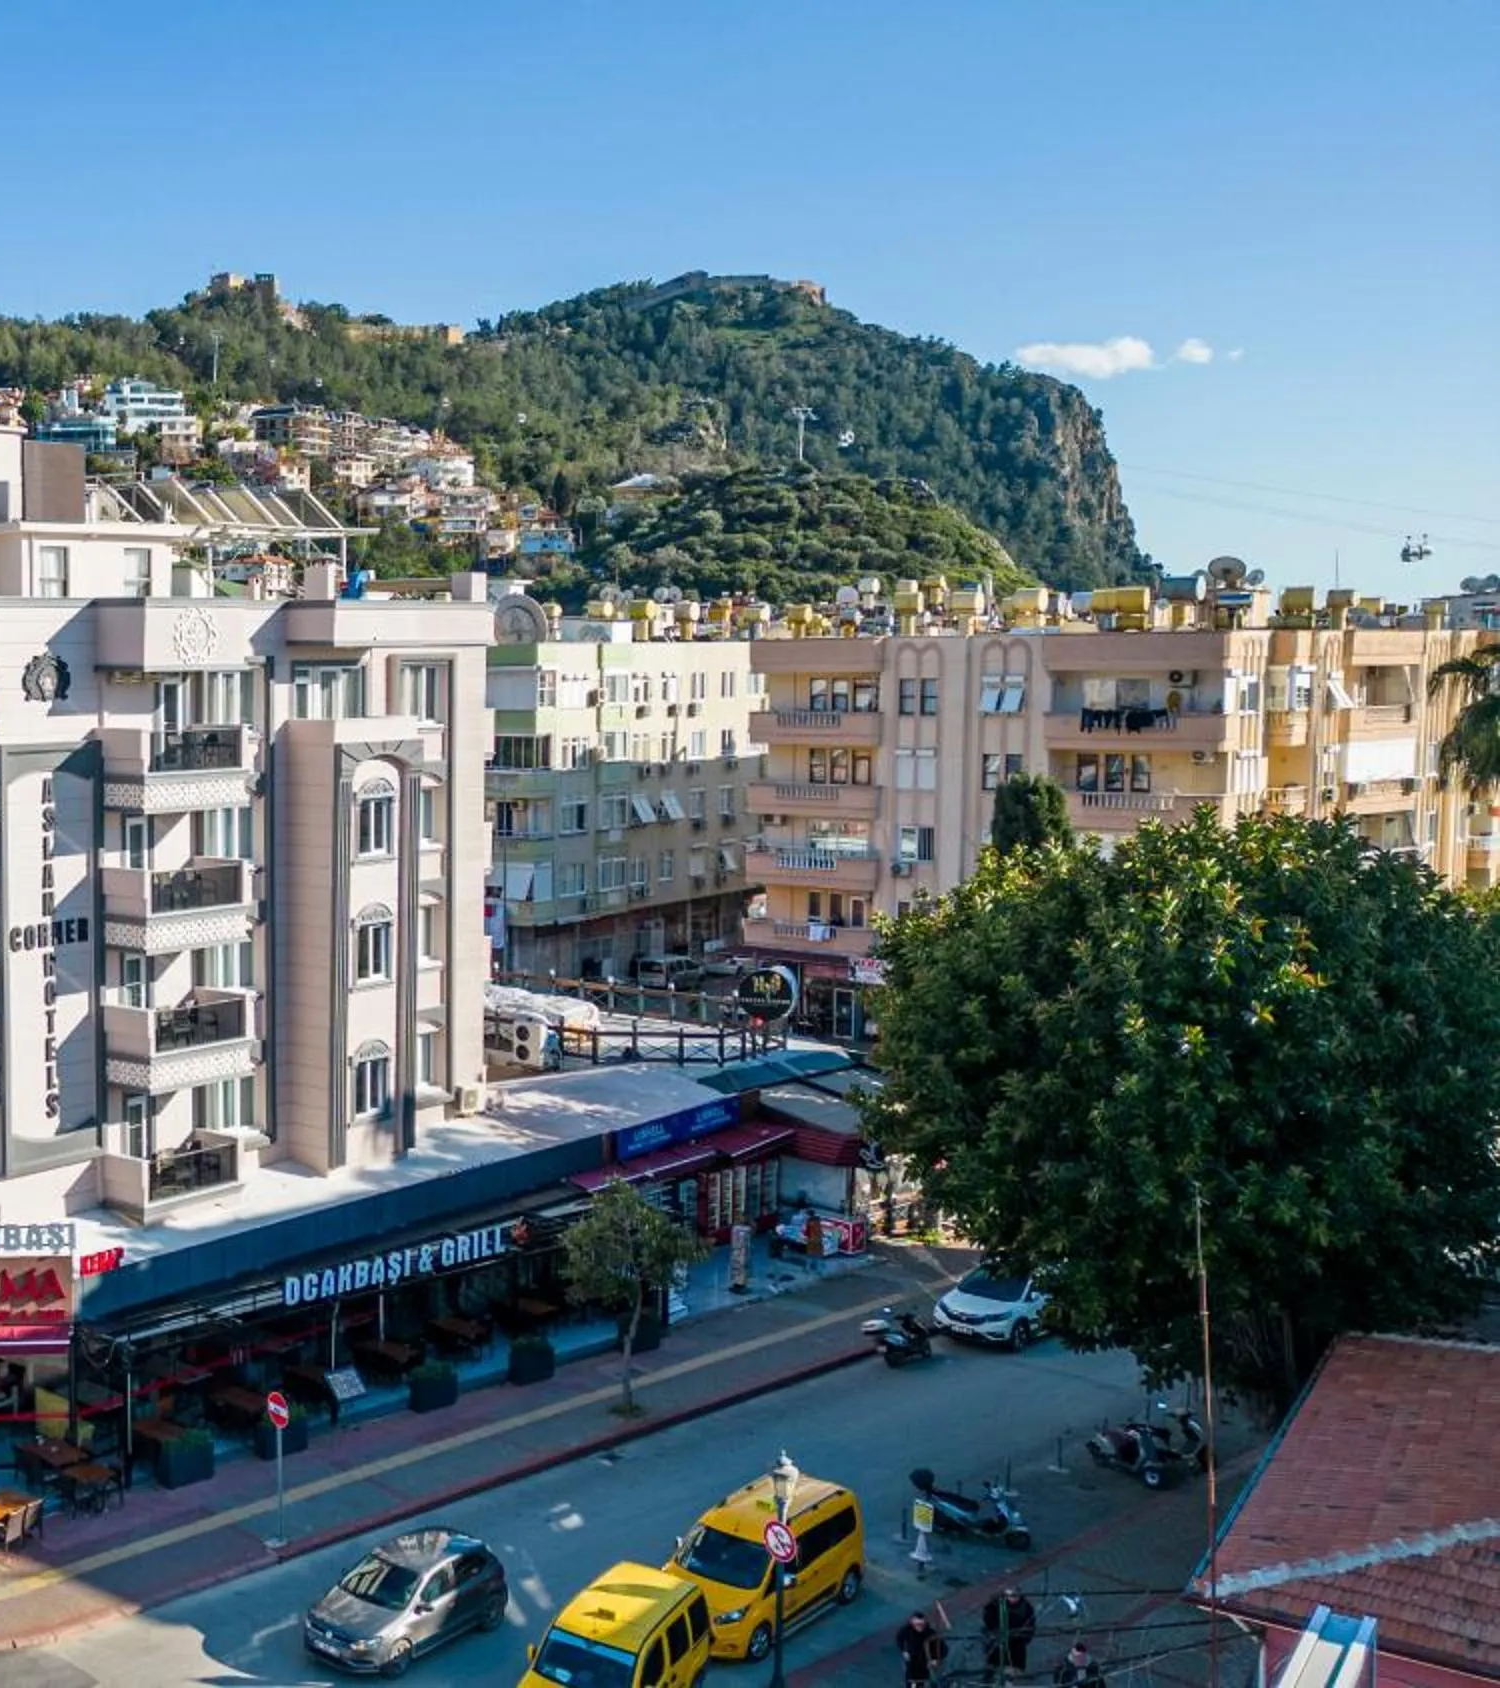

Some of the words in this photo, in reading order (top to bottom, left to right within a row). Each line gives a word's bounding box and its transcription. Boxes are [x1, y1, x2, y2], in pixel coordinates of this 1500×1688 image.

[9, 917, 89, 952] CORNER
[284, 1250, 411, 1306] OCAKBAŞI
[417, 1244, 434, 1273] &
[441, 1226, 506, 1267] GRILL
